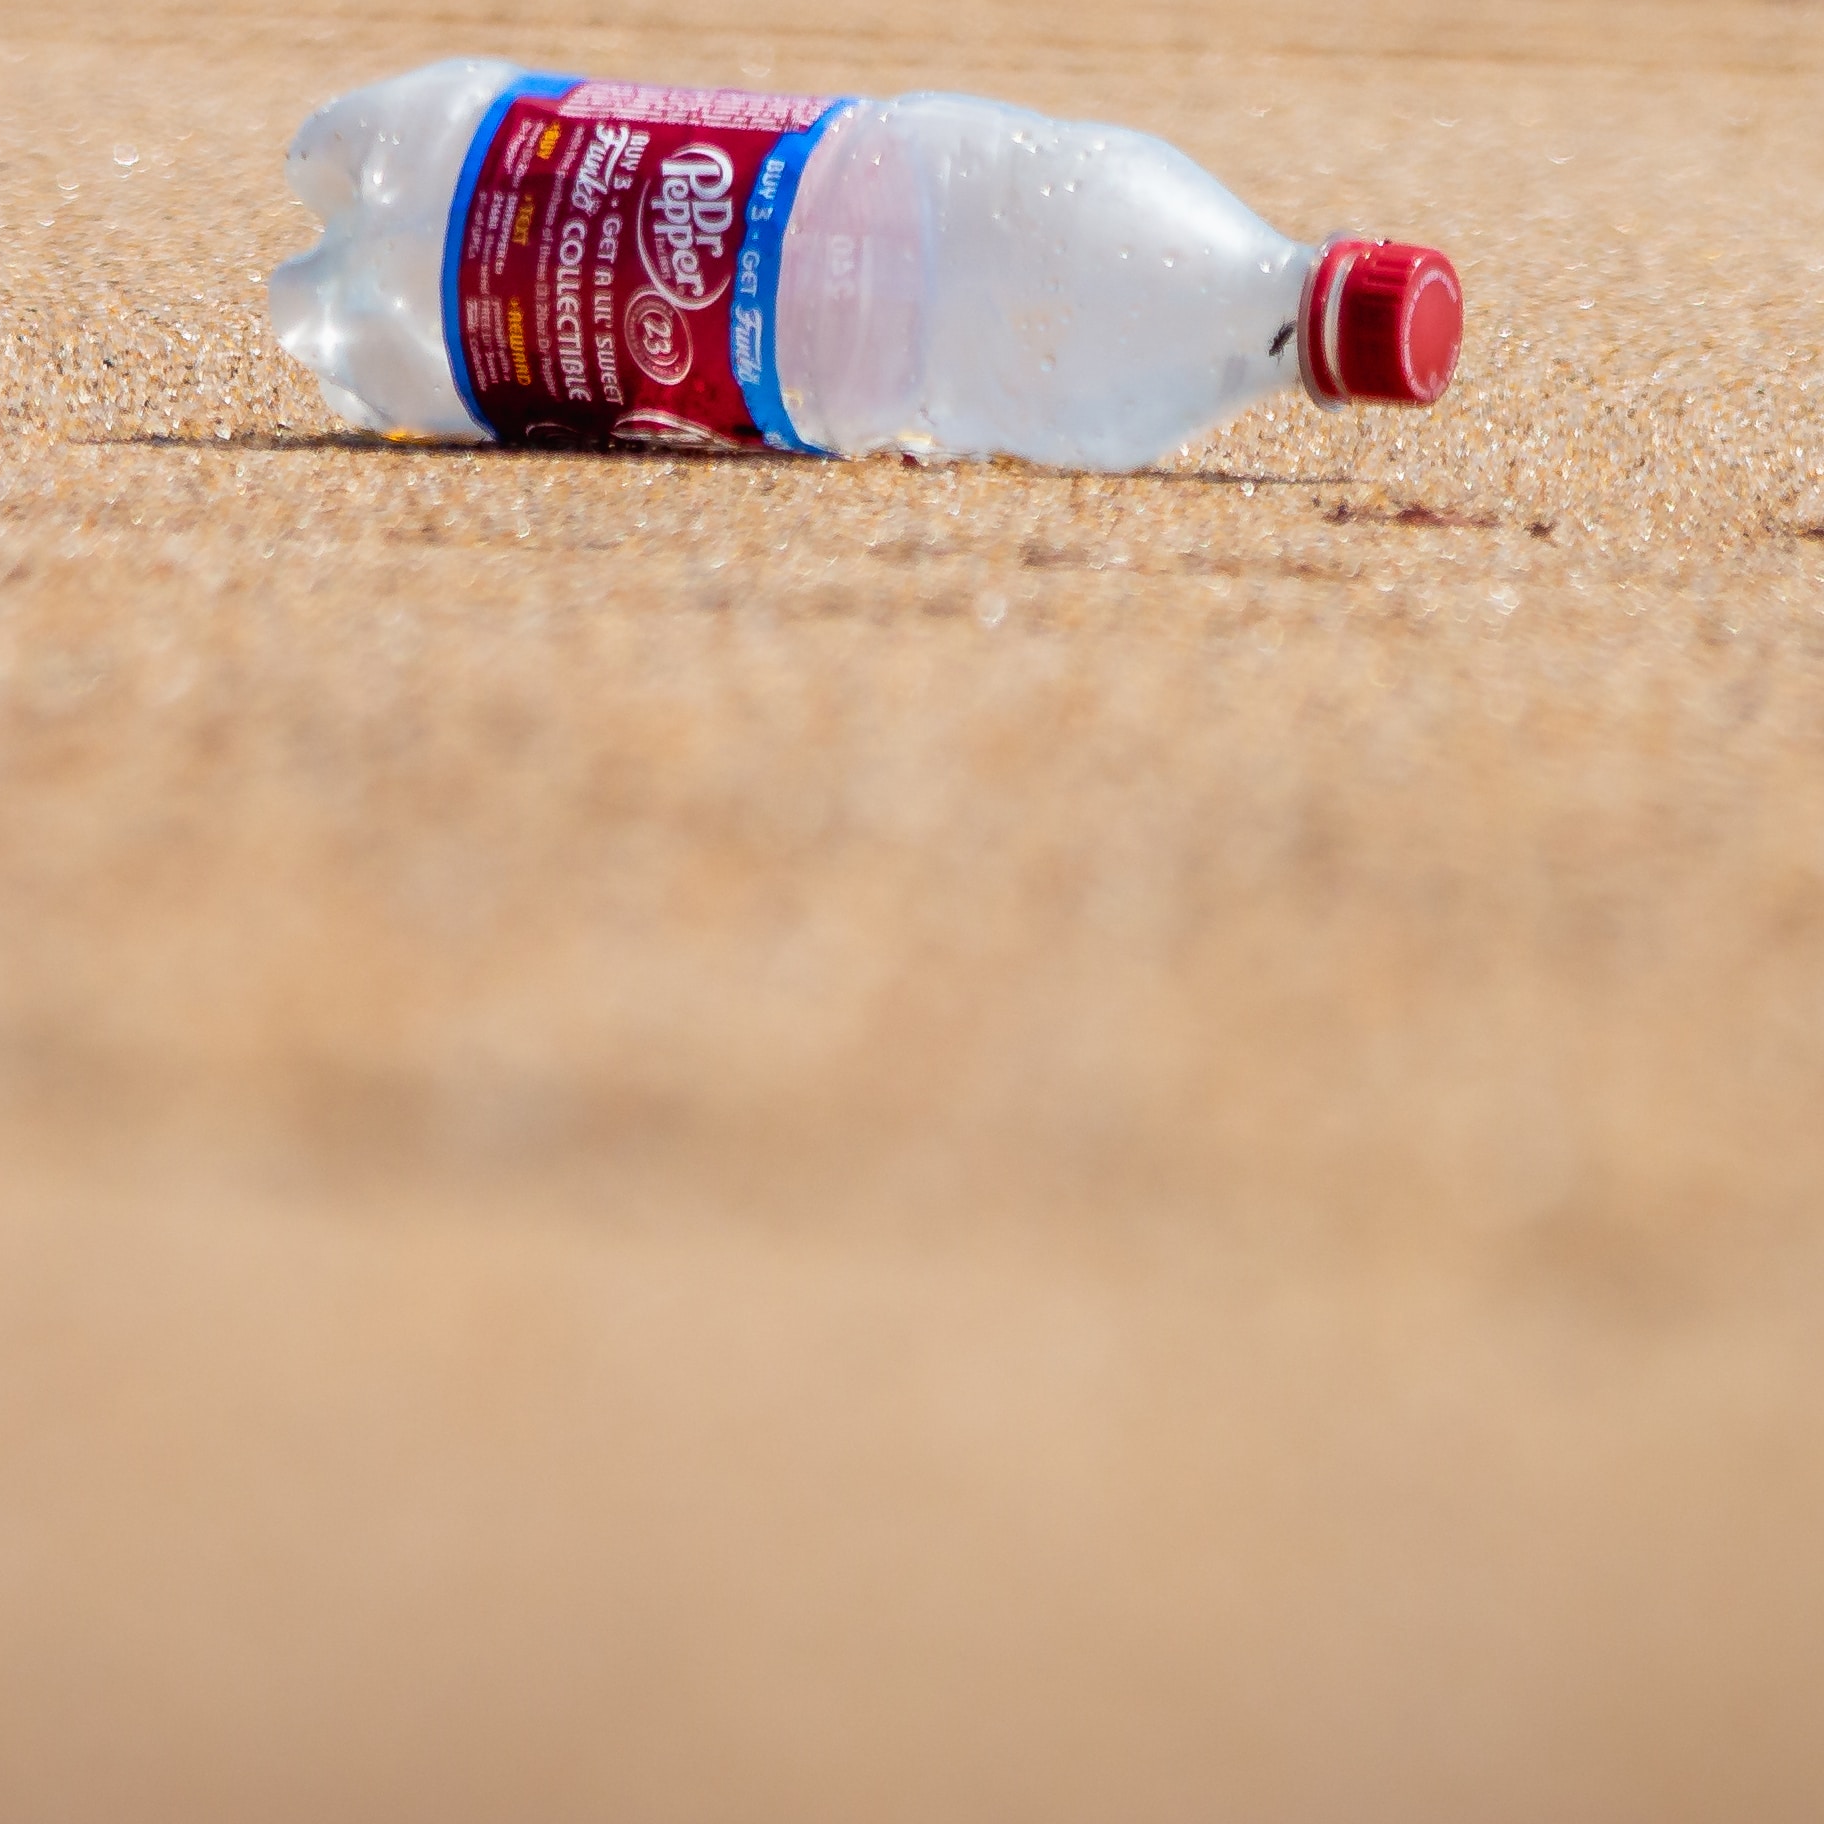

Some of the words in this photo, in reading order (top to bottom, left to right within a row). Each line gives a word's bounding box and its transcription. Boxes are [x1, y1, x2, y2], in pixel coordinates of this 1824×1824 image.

[618, 132, 650, 171] BUY
[612, 174, 633, 190] 3
[756, 159, 785, 199] BUY
[511, 204, 534, 247] TEXT
[650, 144, 734, 296] Pepper
[691, 198, 733, 258] Dr
[749, 202, 773, 221] 3
[596, 215, 623, 264] GET
[594, 267, 613, 285] A
[738, 250, 760, 298] GET
[555, 221, 592, 401] COLLECTIBLE
[506, 311, 532, 386] REWARD
[641, 318, 673, 357] 23
[594, 334, 623, 405] SWEET
